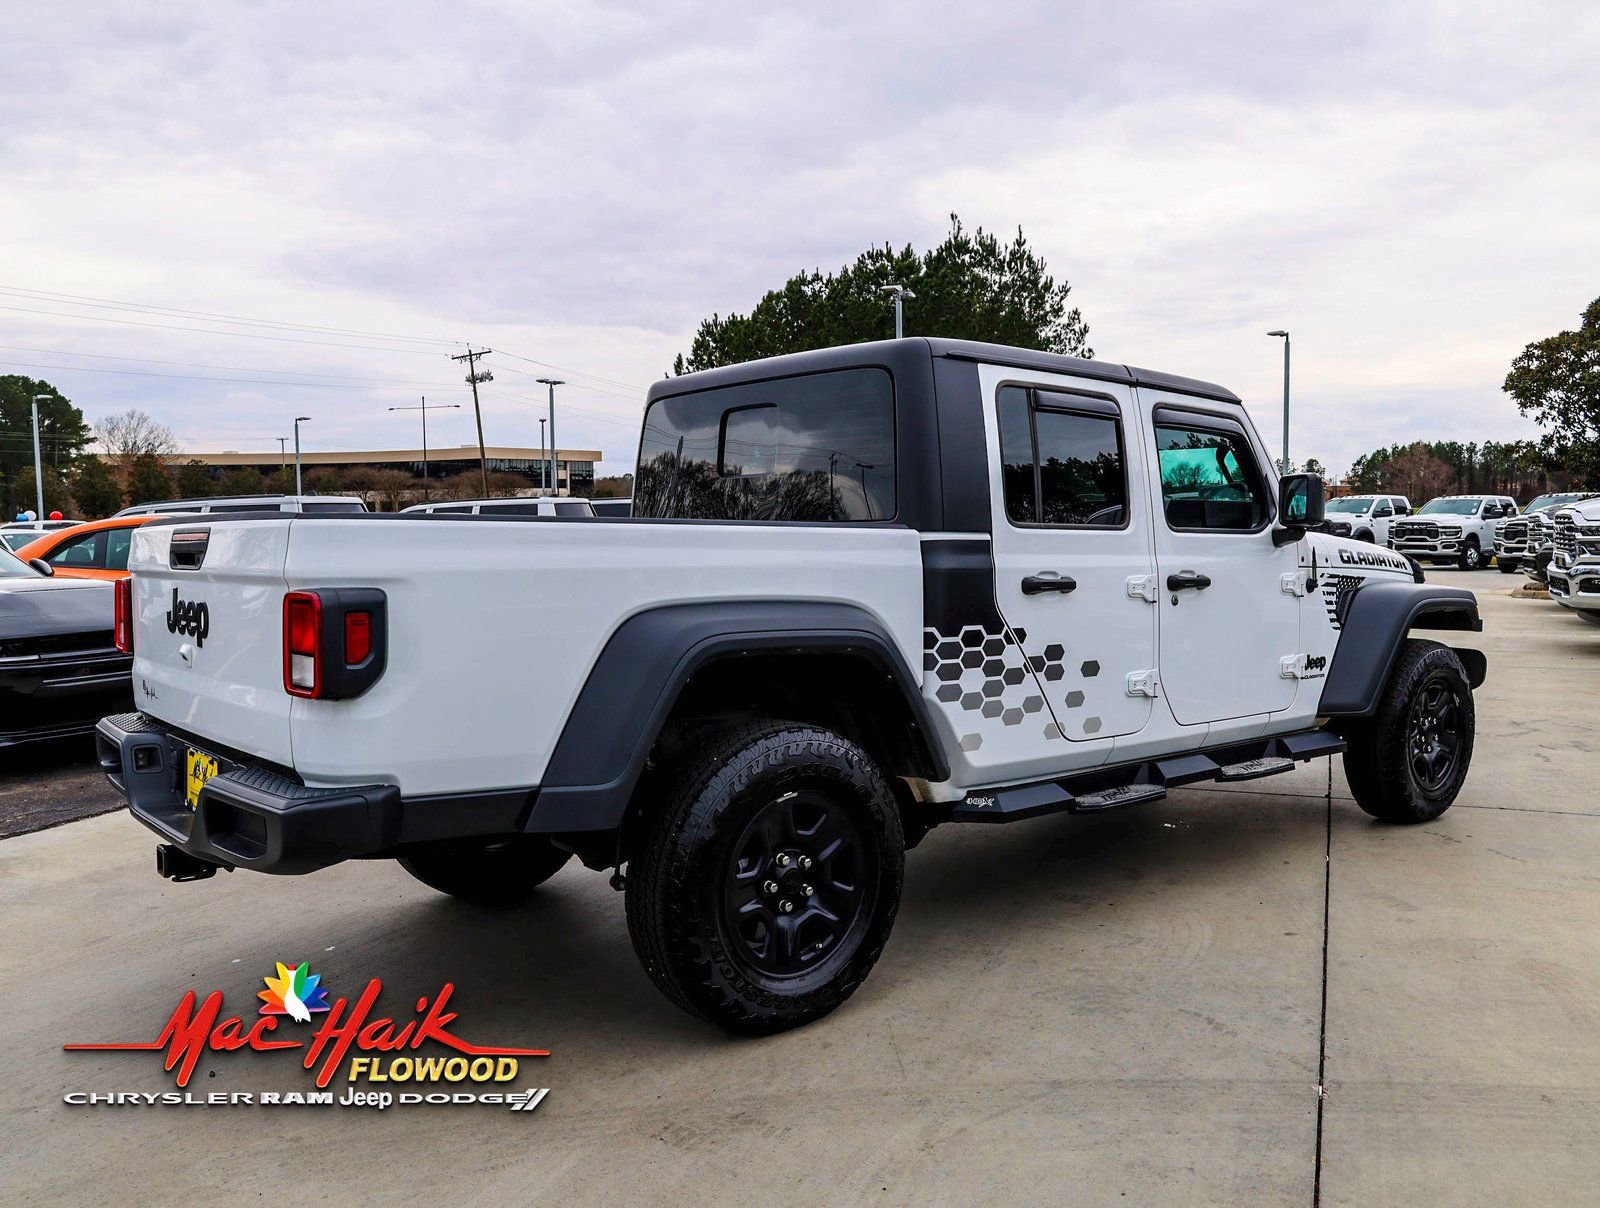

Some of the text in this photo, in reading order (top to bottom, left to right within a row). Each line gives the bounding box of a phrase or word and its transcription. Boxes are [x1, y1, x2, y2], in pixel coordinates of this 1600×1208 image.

[1338, 548, 1408, 571] GLADIATOR
[166, 587, 209, 648] Jeep
[1304, 654, 1326, 671] Jeep
